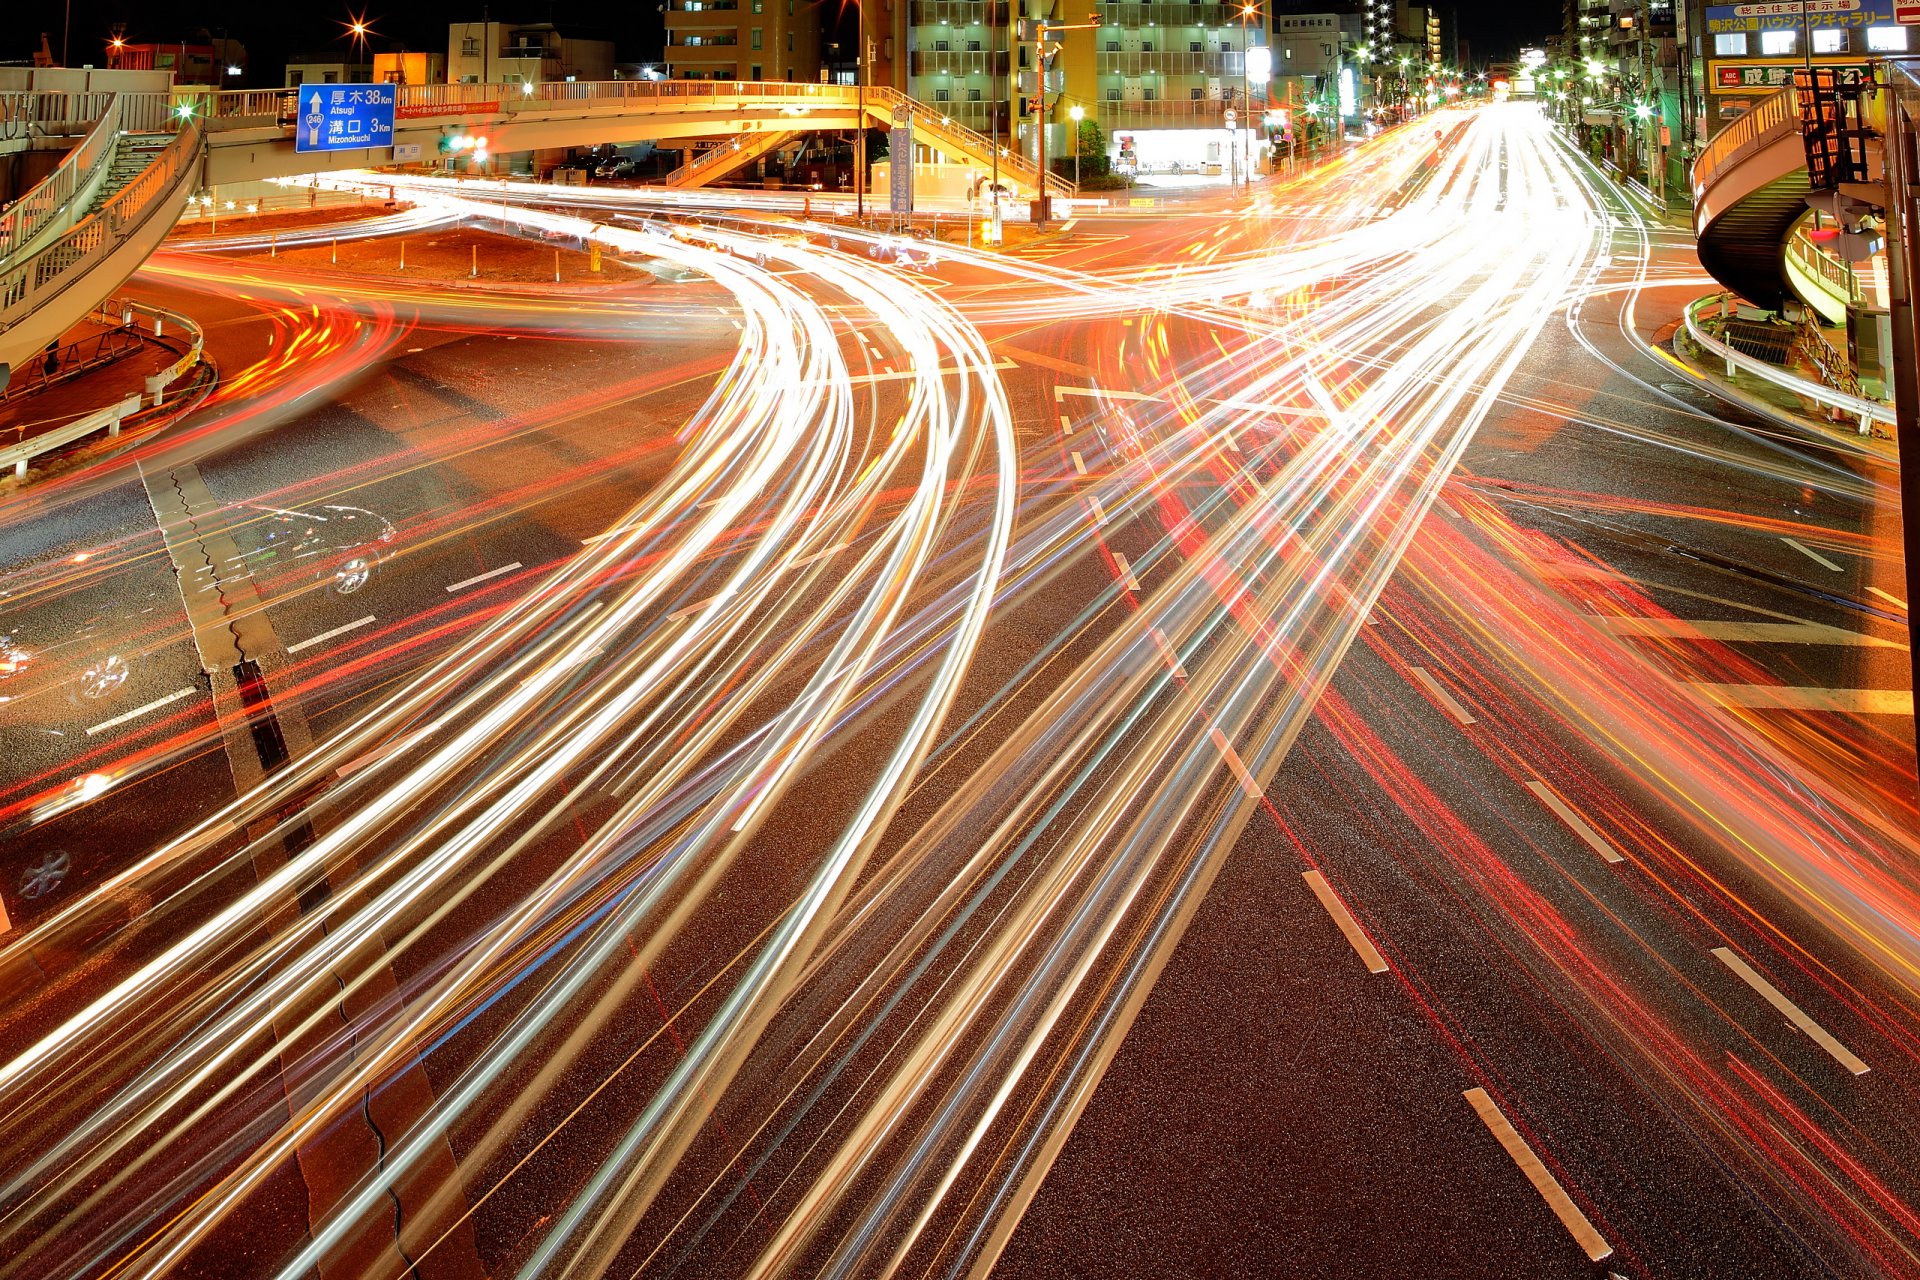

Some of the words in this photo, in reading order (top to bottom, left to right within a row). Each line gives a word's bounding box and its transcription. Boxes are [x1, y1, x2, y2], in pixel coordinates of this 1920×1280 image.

[1740, 0, 1851, 15] 総合住宅展示場
[1708, 11, 1891, 33] 駒沢公園ハウジングギャラリー
[330, 90, 363, 105] 厚木
[330, 106, 355, 115] Atsugi
[309, 116, 322, 124] 246
[328, 119, 361, 135] 溝口
[328, 134, 371, 144] Mizonokuchi
